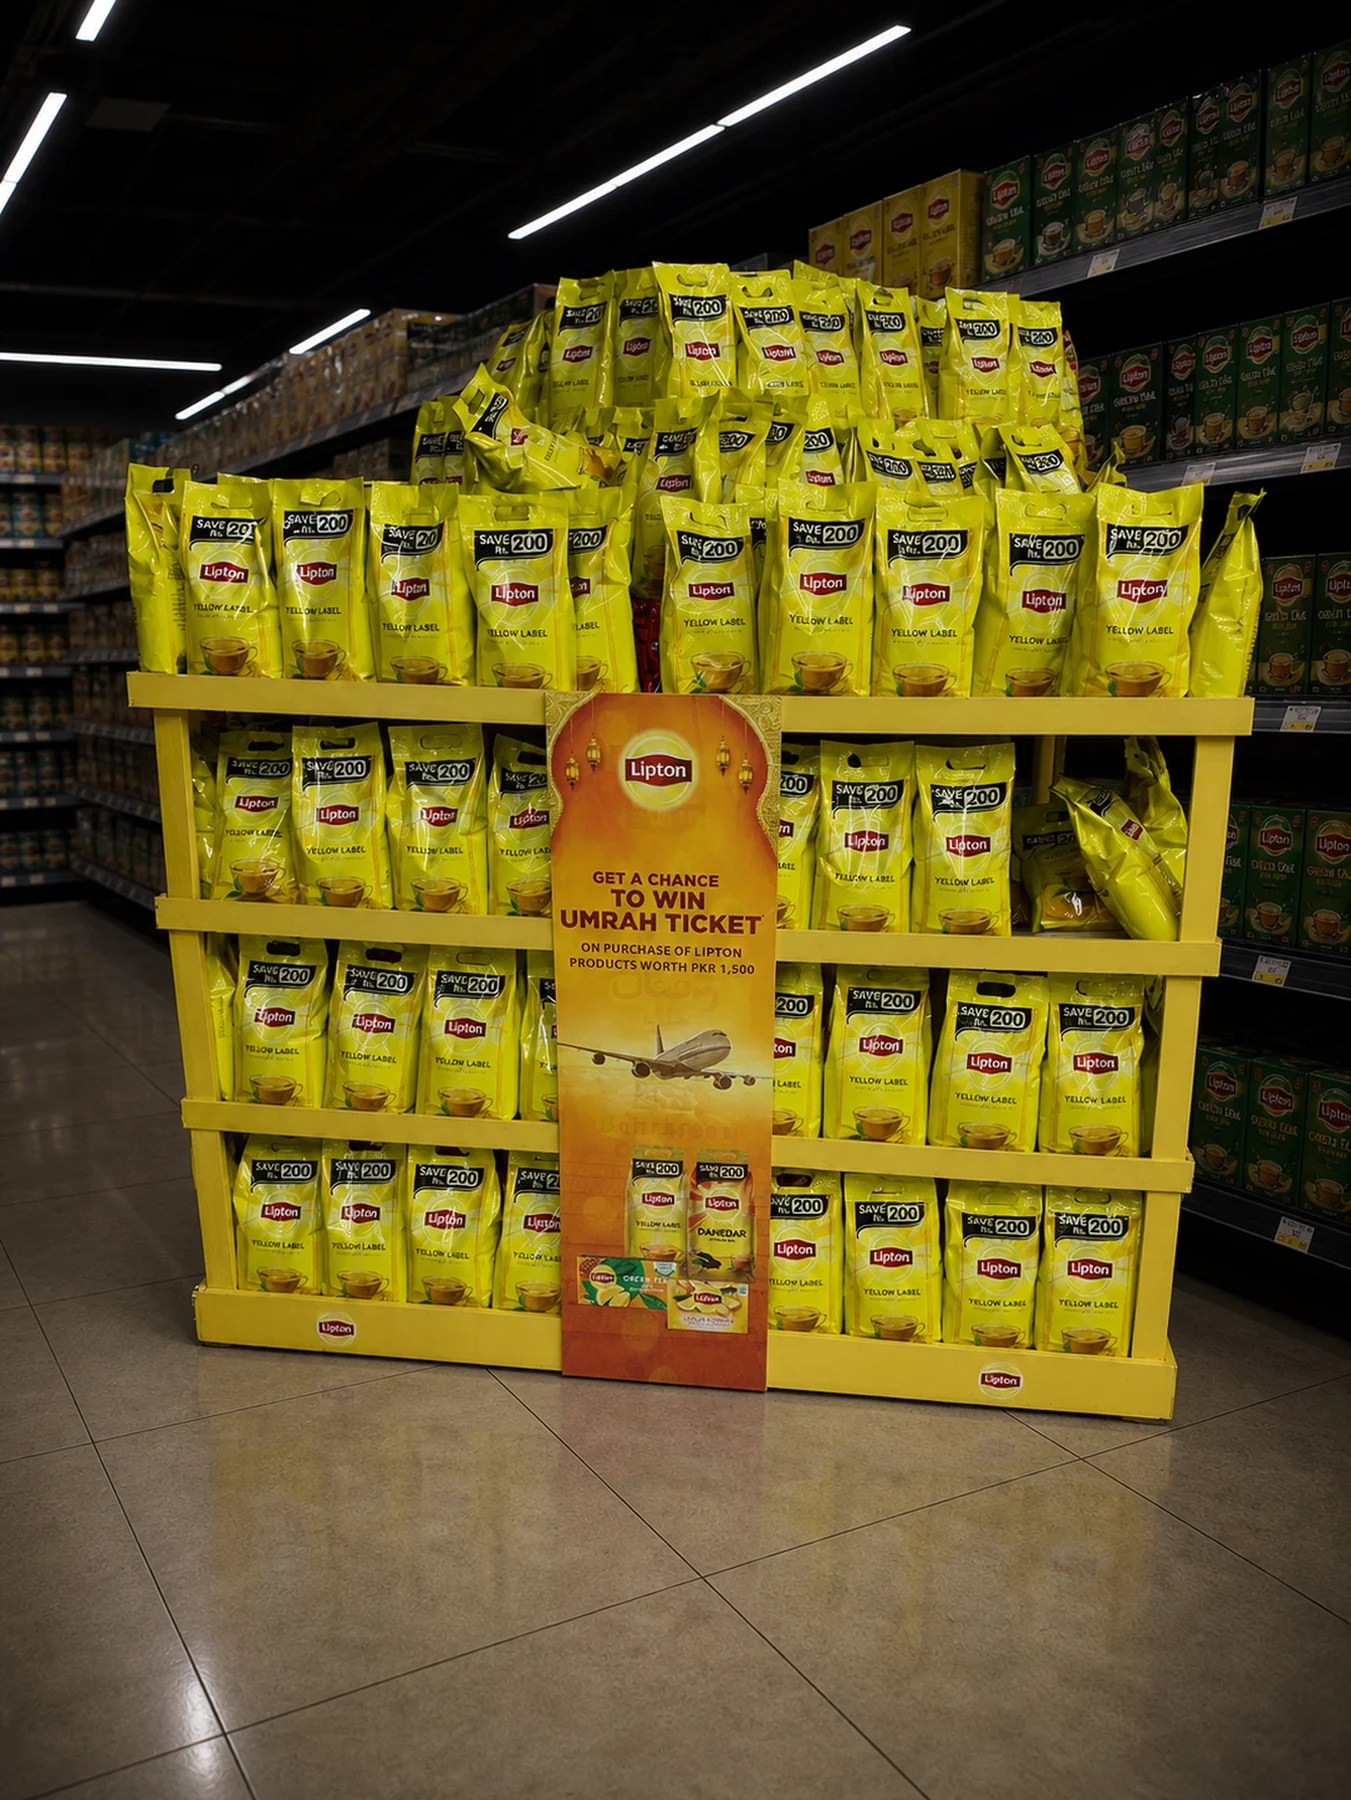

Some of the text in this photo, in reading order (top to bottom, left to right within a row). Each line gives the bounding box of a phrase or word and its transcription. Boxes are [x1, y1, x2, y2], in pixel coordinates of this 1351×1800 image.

[696, 301, 719, 314] 200
[196, 519, 226, 530] SAVE
[319, 517, 346, 531] 200
[793, 522, 857, 542] SAVE 200
[1110, 529, 1179, 547] SAVE 200
[479, 535, 545, 550] SAVE 200
[573, 533, 600, 547] 200
[893, 533, 960, 552] SAVE 200
[1014, 536, 1078, 557] SAVE 200
[704, 541, 734, 557] 200
[204, 566, 245, 581] Lipton
[300, 566, 334, 581] Lipton
[803, 575, 843, 590] Lipton
[495, 585, 535, 601] Lipton
[693, 585, 731, 595] Lipton
[906, 586, 946, 600] Lipton
[1121, 583, 1165, 596] Lipton
[1026, 594, 1063, 606] Lipton
[684, 618, 718, 627] YELLOW
[892, 628, 957, 638] YELLOW LABEL
[1106, 625, 1174, 635] YELLOW LABEL
[336, 761, 364, 775] 200
[439, 765, 469, 778] 200
[631, 760, 687, 780] Lipton
[837, 785, 896, 801] SAVE 200
[934, 789, 998, 804] SAVE 200
[239, 798, 275, 807] Lipton
[321, 809, 356, 820] Lipton
[848, 834, 886, 847] Lipton
[949, 839, 987, 852] Lipton
[593, 871, 719, 888] GET A CHANCE
[610, 889, 705, 910] TO WIN
[560, 909, 762, 935] UMRAH TICKET
[581, 942, 742, 958] ON PURCHASE OF LIPTON
[570, 958, 754, 975] PRODUCTS WORTH PKR 1,500
[281, 968, 309, 982] 200
[378, 973, 407, 989] 200
[469, 979, 498, 993] 200
[777, 998, 806, 1012] 200
[853, 990, 913, 1008] SAVE 200
[259, 1011, 292, 1024] Lipton
[961, 1006, 1025, 1027] SAVE 200
[1063, 1007, 1128, 1025] SAVE 200
[356, 1016, 392, 1030] Lipton
[449, 1022, 482, 1034] Lipton
[863, 1040, 899, 1052] Lipton
[971, 1056, 1008, 1069] Lipton
[1077, 1057, 1114, 1070] Lipton
[850, 1076, 908, 1085] YELLOW LABEL
[282, 1165, 310, 1178] 200
[363, 1164, 389, 1178] 200
[657, 1163, 679, 1174] 200
[722, 1167, 743, 1178] 200
[420, 1166, 477, 1185] SAVE 200
[520, 1171, 546, 1181] SAVE
[644, 1194, 673, 1203] Lipton
[264, 1207, 298, 1217] Lipton
[793, 1199, 821, 1213] 200
[859, 1204, 918, 1221] SAVE 200
[344, 1208, 378, 1218] Lipton
[428, 1213, 463, 1226] Lipton
[967, 1216, 1027, 1233] SAVE 200
[1059, 1215, 1121, 1233] SAVE 200
[698, 1228, 746, 1238] DANEDAR
[777, 1245, 813, 1255] Lipton
[874, 1252, 909, 1263] Lipton
[981, 1262, 1018, 1275] Lipton
[1071, 1263, 1109, 1275] Lipton
[864, 1288, 921, 1296] YELLOW LABEL
[969, 1298, 1000, 1307] YELLOW
[322, 1324, 352, 1333] Lipton
[984, 1375, 1017, 1385] Lipton
